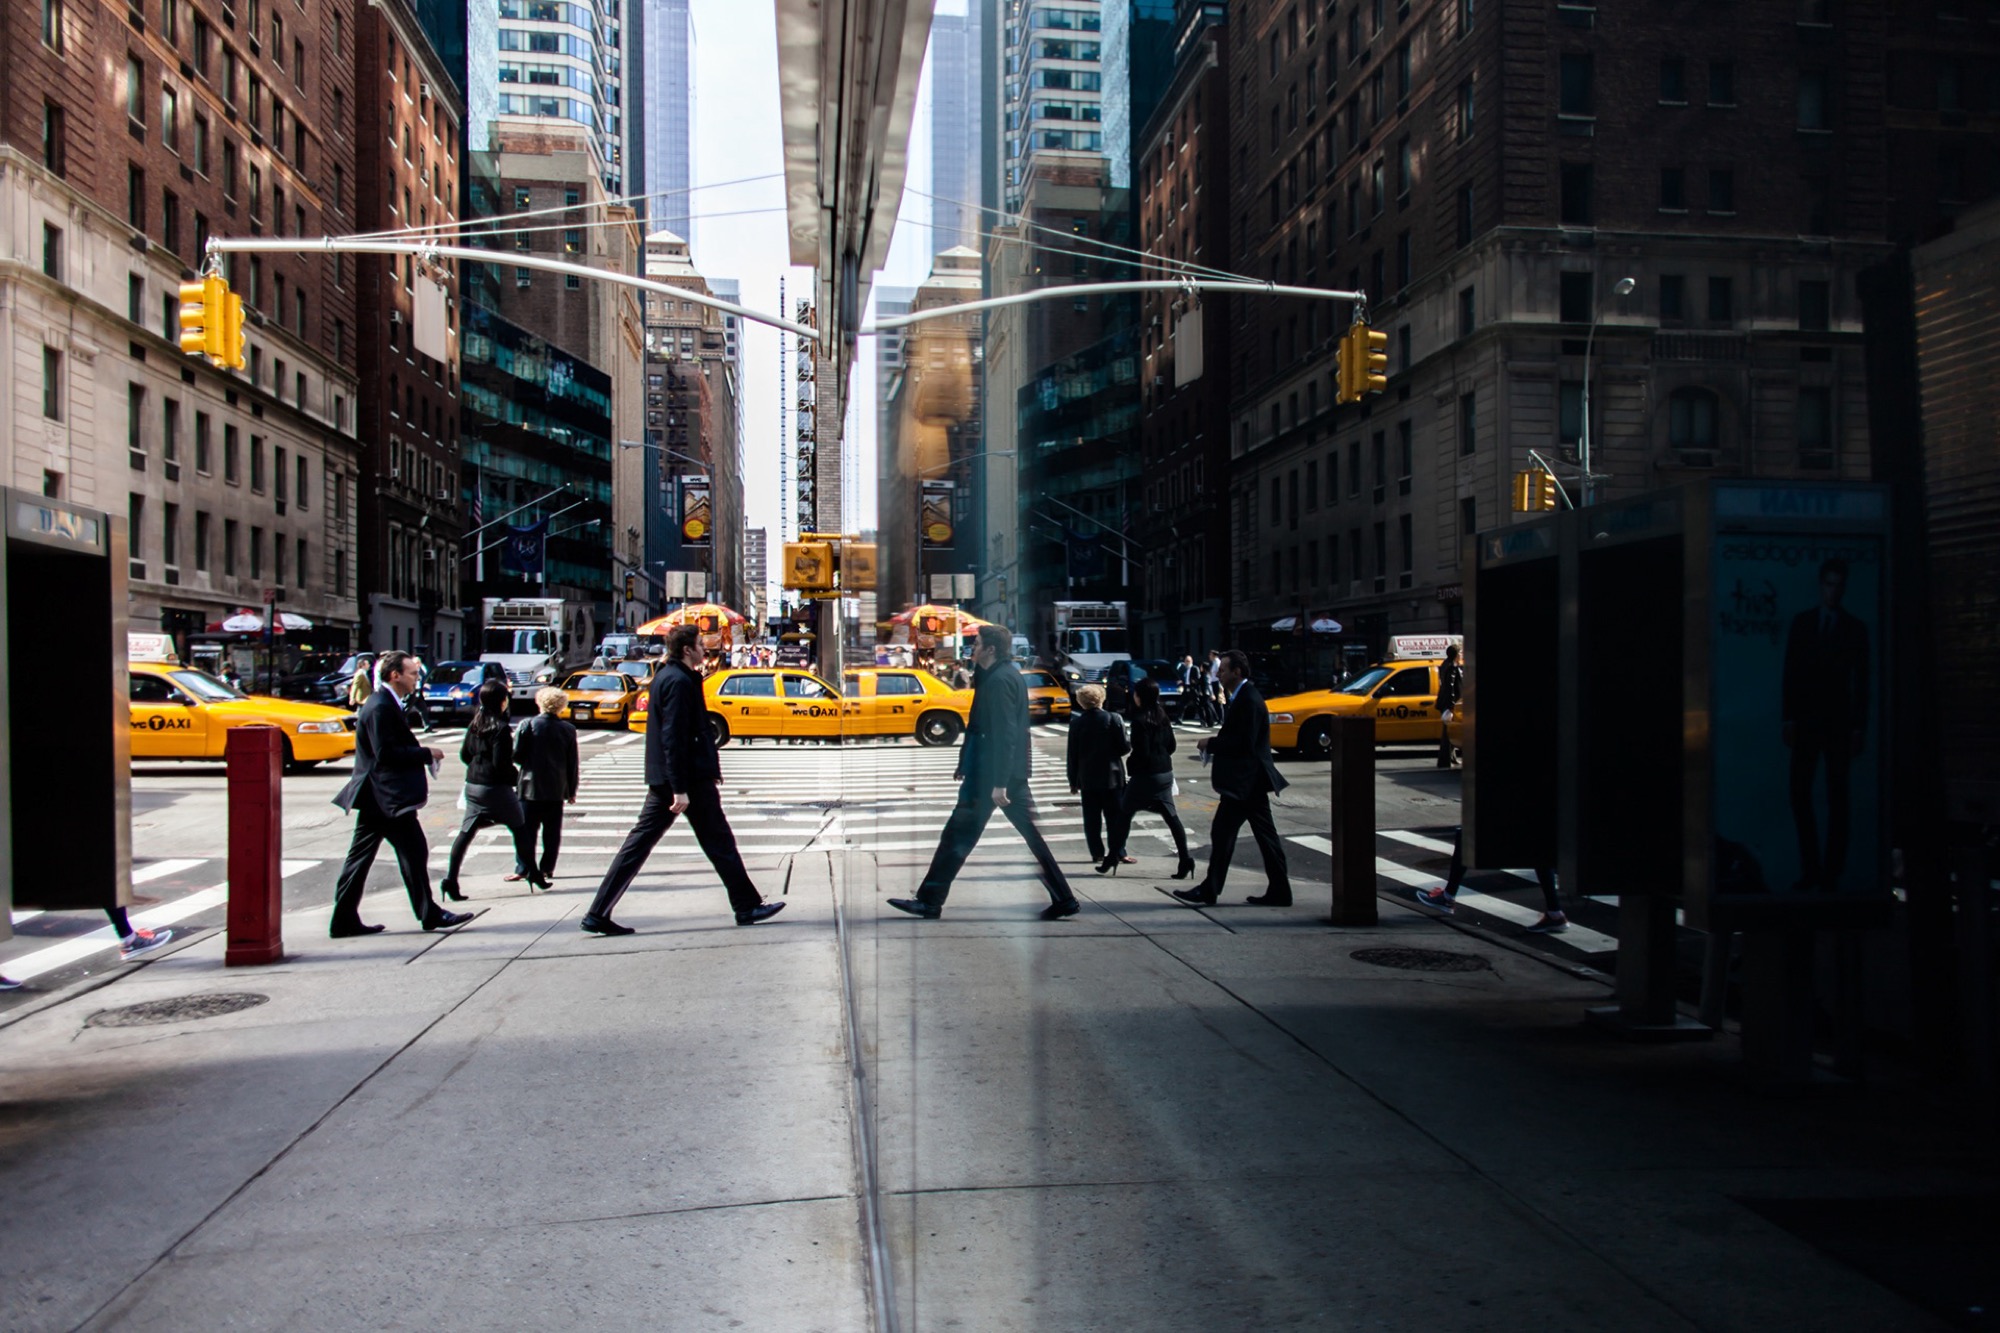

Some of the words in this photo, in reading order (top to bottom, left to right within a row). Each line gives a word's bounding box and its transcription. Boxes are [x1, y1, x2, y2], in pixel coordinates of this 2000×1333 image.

[792, 708, 808, 716] NYC
[809, 705, 838, 718] TAXI
[149, 715, 191, 731] TAXI
